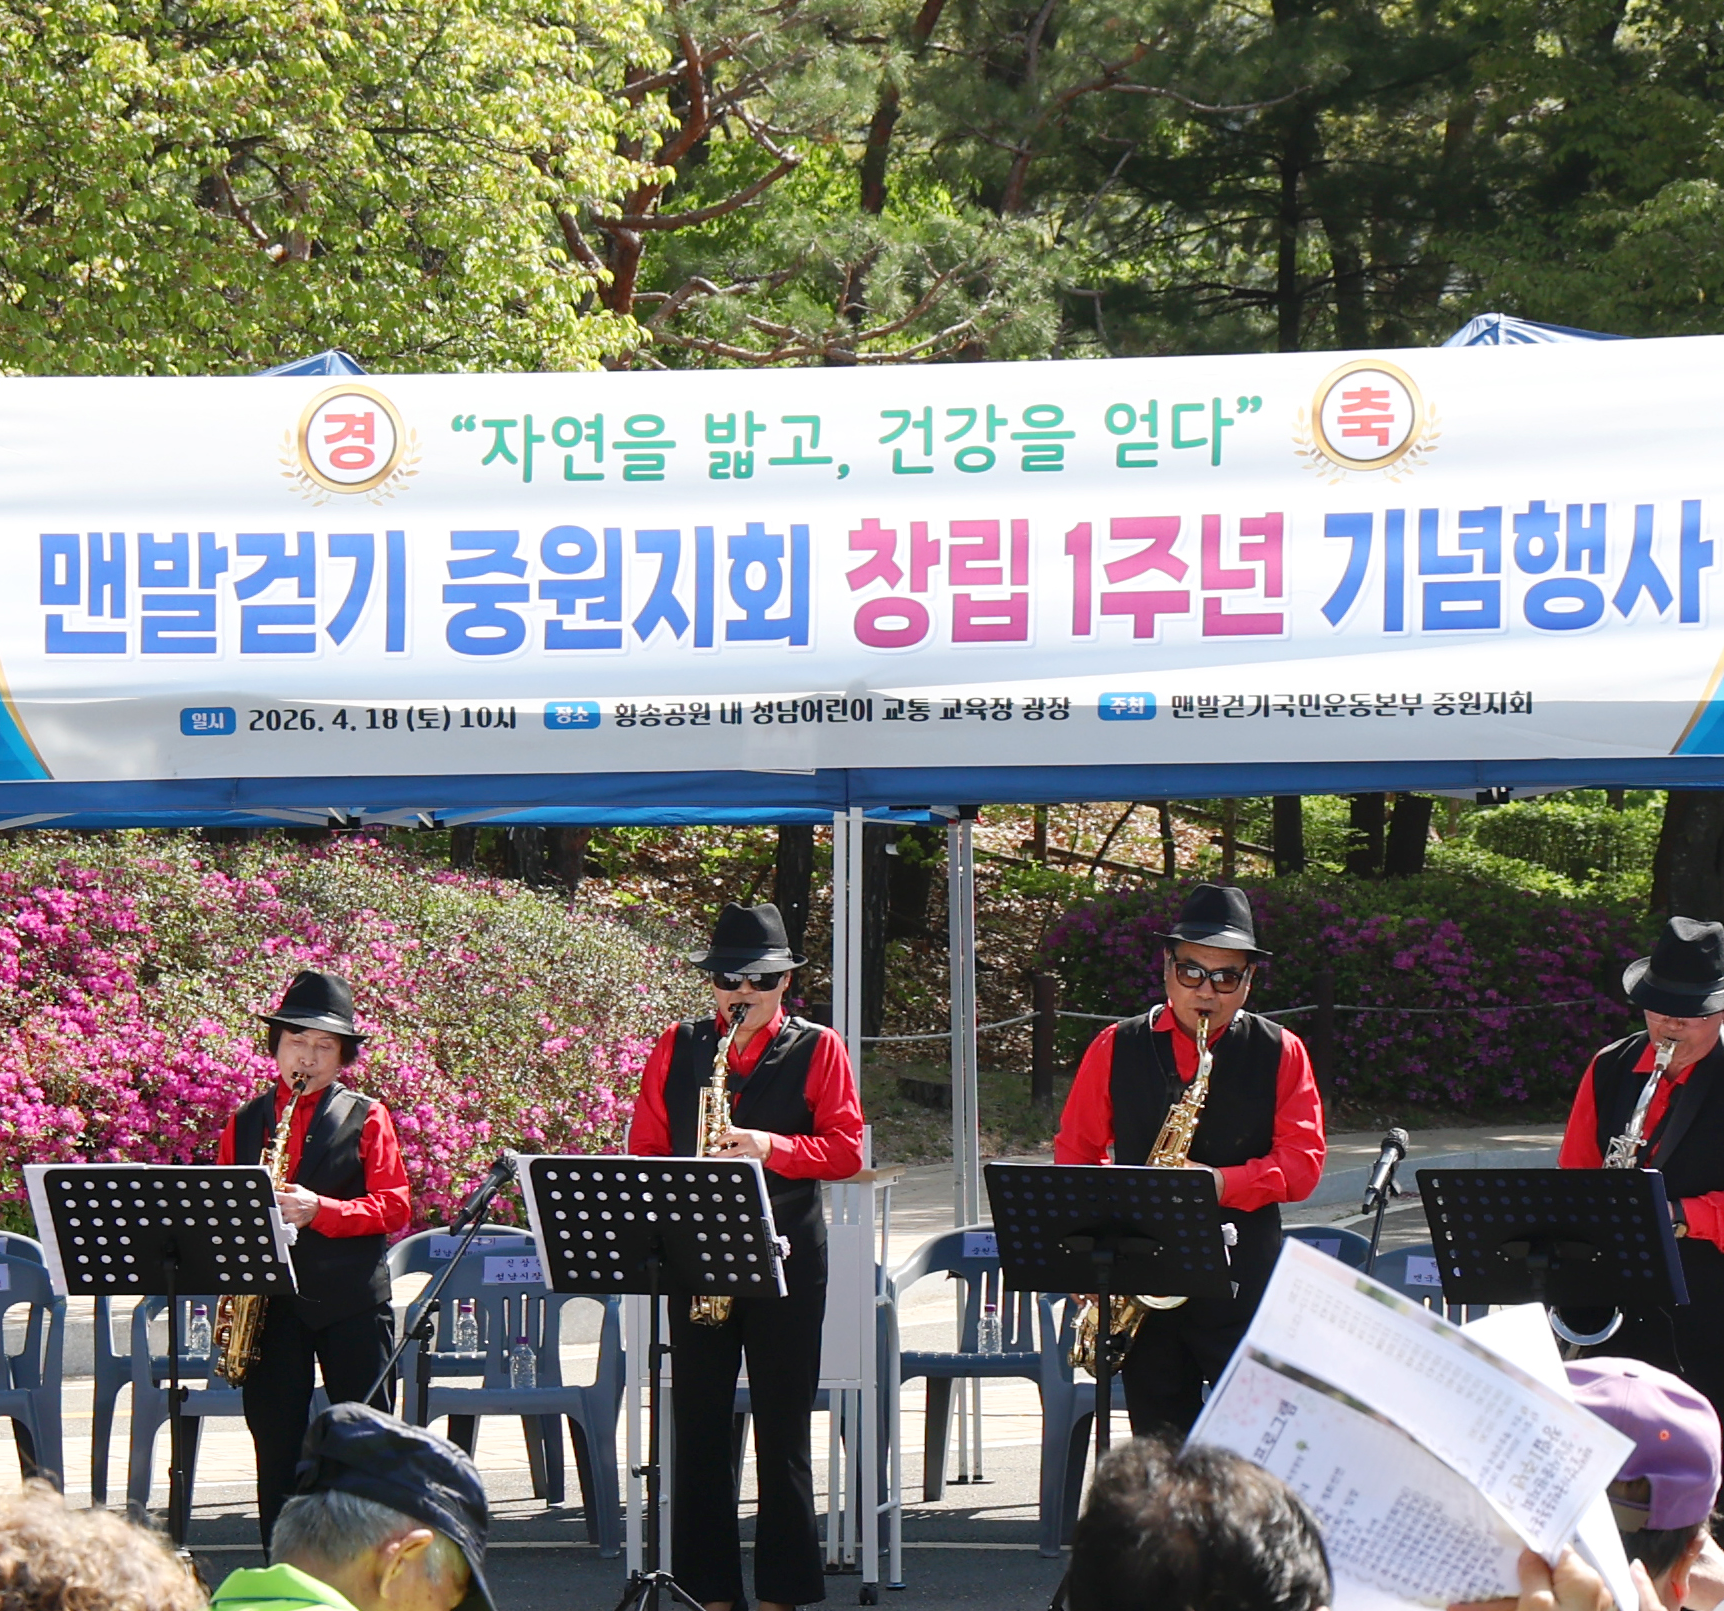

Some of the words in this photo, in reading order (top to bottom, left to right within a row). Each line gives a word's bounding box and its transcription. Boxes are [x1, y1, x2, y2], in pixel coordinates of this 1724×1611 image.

[325, 413, 375, 470] 경
[451, 414, 677, 484] “자연을
[705, 410, 851, 481] 밟고,
[879, 404, 1076, 476] 건강을
[1105, 395, 1263, 469] 얻다”
[1337, 386, 1395, 448] 축
[40, 530, 407, 655] 맨발걷기
[443, 522, 810, 657] 중원지회
[846, 518, 1030, 650] 창립
[1064, 512, 1284, 640] 1주년
[1321, 499, 1714, 633] 기념행사
[191, 712, 224, 730] 일시
[248, 708, 324, 732] 2026.
[331, 708, 357, 732] 4.
[365, 708, 398, 730] 18
[406, 706, 451, 732] (토)
[460, 707, 516, 729] 10시
[554, 705, 589, 724] 장소
[614, 703, 711, 727] 황송공원
[720, 702, 742, 725] 내
[751, 698, 873, 725] 성남어린이
[881, 698, 931, 722] 교통
[939, 697, 1014, 722] 교육장
[1021, 697, 1071, 722] 광장
[1108, 695, 1146, 716] 주최
[1171, 693, 1424, 719] 맨발걷기국민운동본부
[1432, 690, 1533, 716] 중원지회
[495, 1272, 543, 1281] 성남시장
